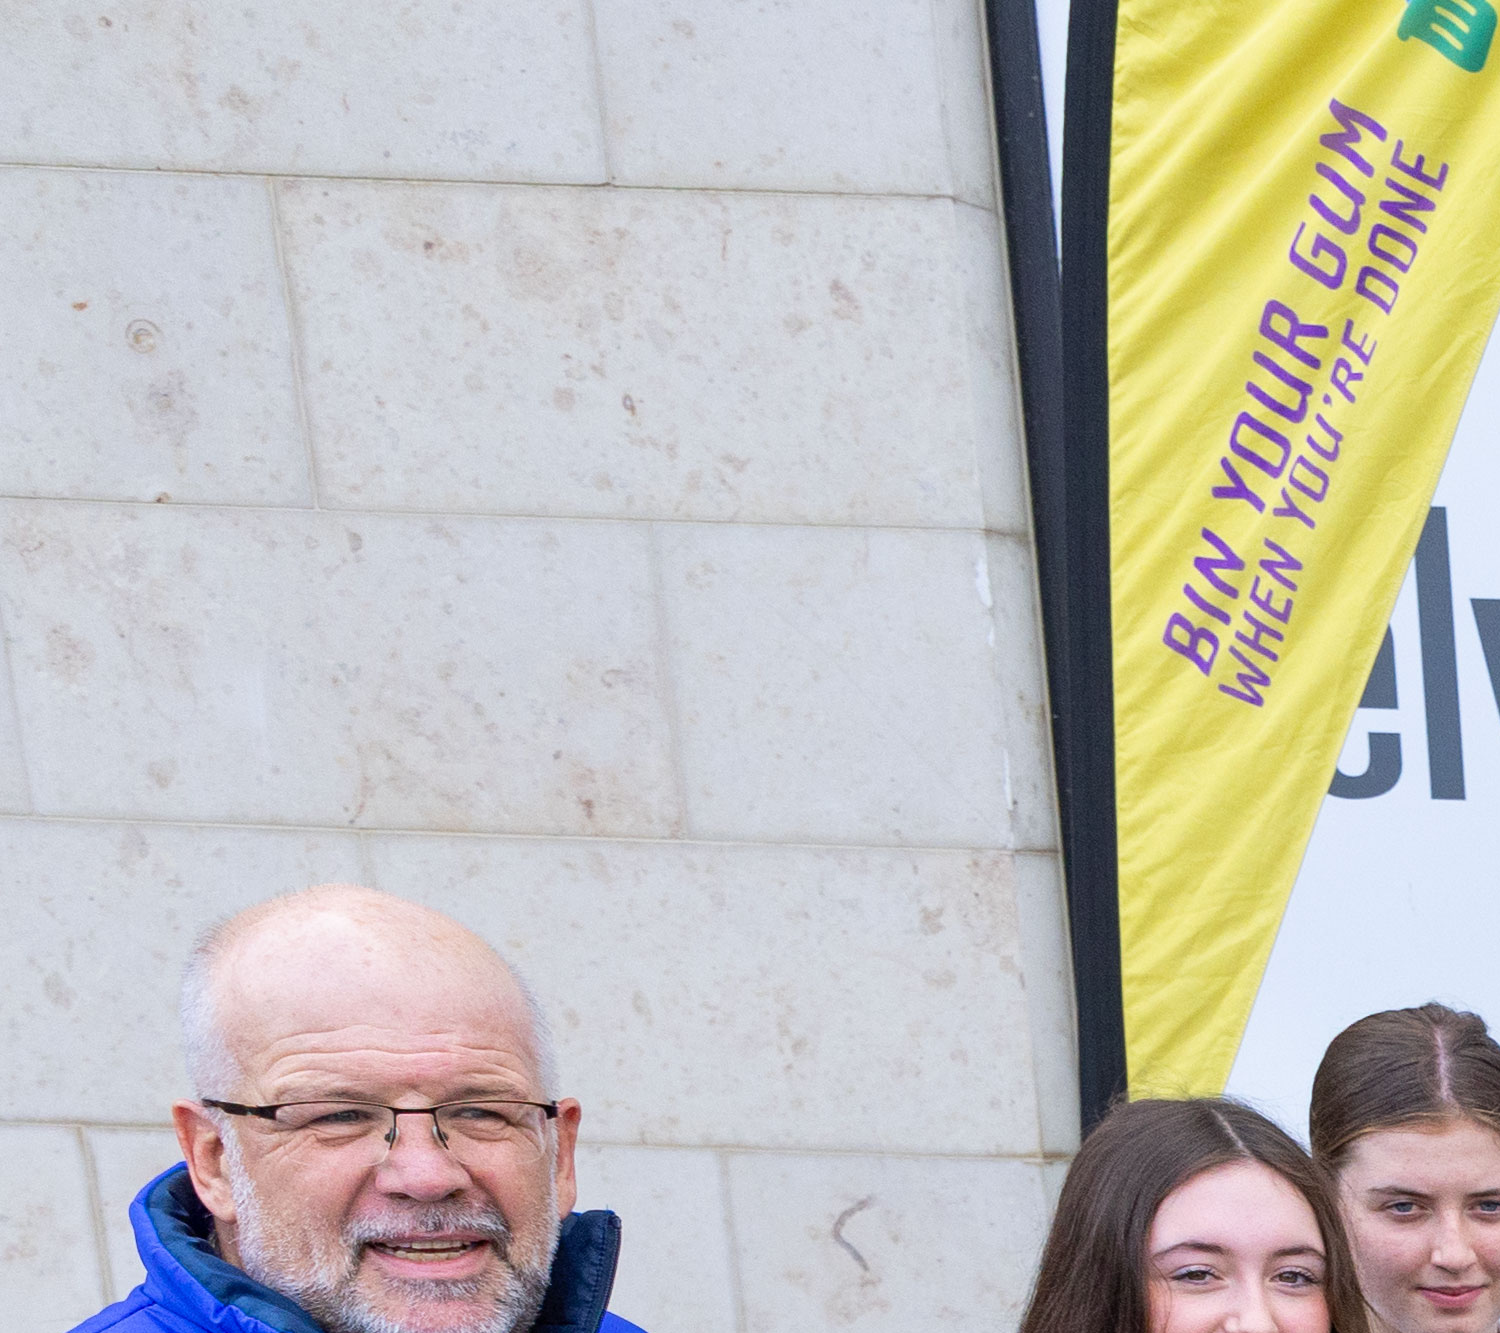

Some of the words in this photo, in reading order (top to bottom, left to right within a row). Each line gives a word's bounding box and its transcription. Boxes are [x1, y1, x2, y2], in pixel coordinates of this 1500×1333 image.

[1163, 527, 1245, 676] BIN
[1212, 300, 1329, 512] YOUR
[1289, 98, 1388, 289] GUM
[1219, 539, 1303, 707] WHEN
[1273, 319, 1378, 529] YOU'RE
[1355, 139, 1449, 314] DONE
